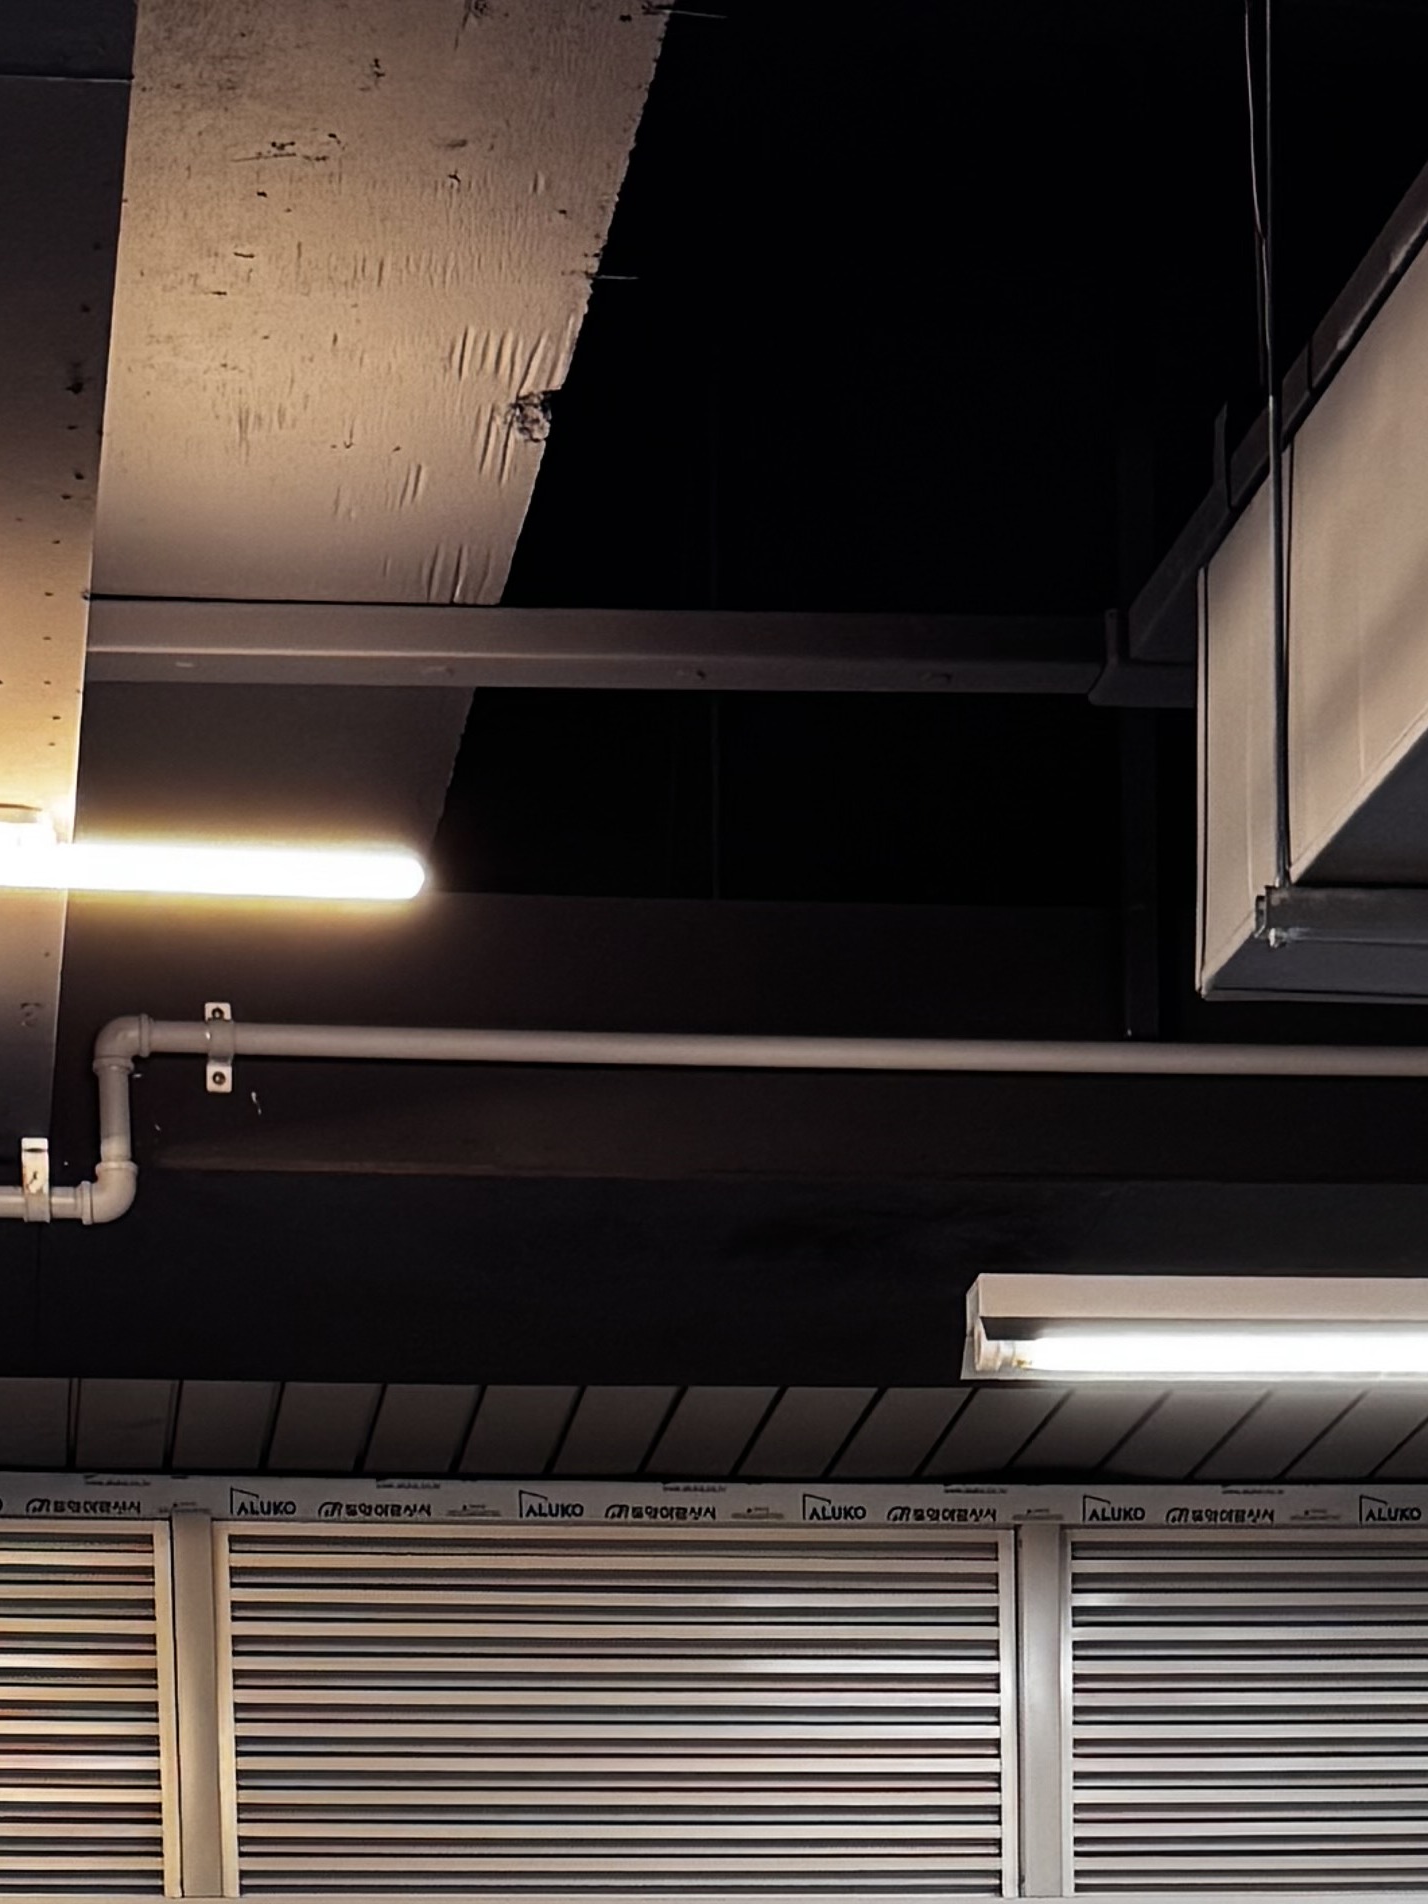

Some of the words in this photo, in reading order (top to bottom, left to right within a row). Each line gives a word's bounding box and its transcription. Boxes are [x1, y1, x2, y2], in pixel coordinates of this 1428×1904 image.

[237, 1501, 296, 1516] ALUKO
[526, 1503, 584, 1518] ALUKO
[809, 1506, 867, 1520] ALUKO
[1089, 1507, 1145, 1521] ALUKO
[1366, 1507, 1421, 1521] ALUKO
